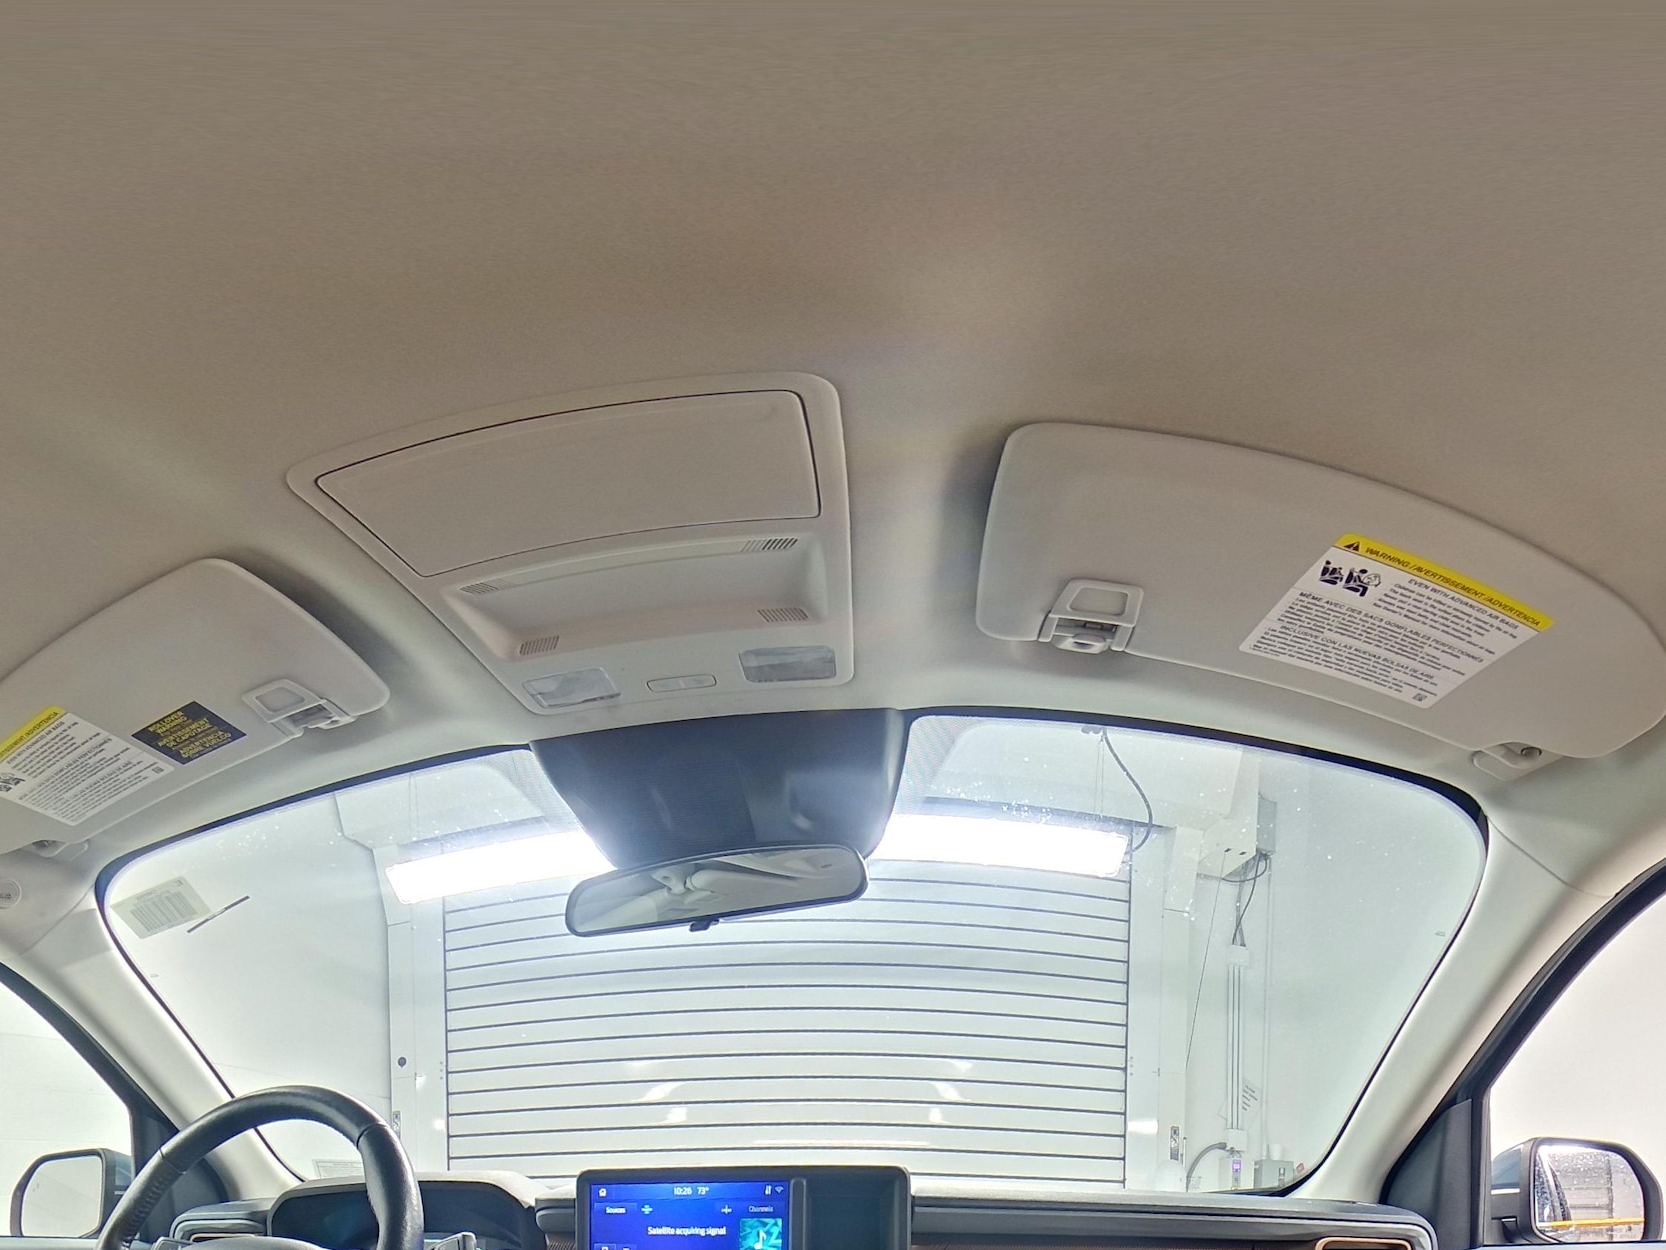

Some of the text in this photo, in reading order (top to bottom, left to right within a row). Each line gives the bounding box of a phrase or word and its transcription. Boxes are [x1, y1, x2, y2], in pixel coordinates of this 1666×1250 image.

[1365, 547, 1410, 568] WARNING
[1408, 579, 1520, 630] EVEN WITH ADVANCED AIR BAGS
[1299, 591, 1323, 602] MÊME
[1324, 600, 1346, 610] AVEC
[1363, 611, 1384, 622] SACS
[1384, 619, 1431, 641] GONFLABLES
[1321, 637, 1338, 645] CON
[148, 711, 184, 732] ROLLOVER
[155, 716, 188, 734] WARNING
[157, 718, 209, 747] AVERTISSEMENT
[674, 1186, 692, 1195] 10:26
[605, 1206, 626, 1214] Sources
[748, 1205, 773, 1213] Channels
[647, 1226, 727, 1237] Satellite acquiring signal
